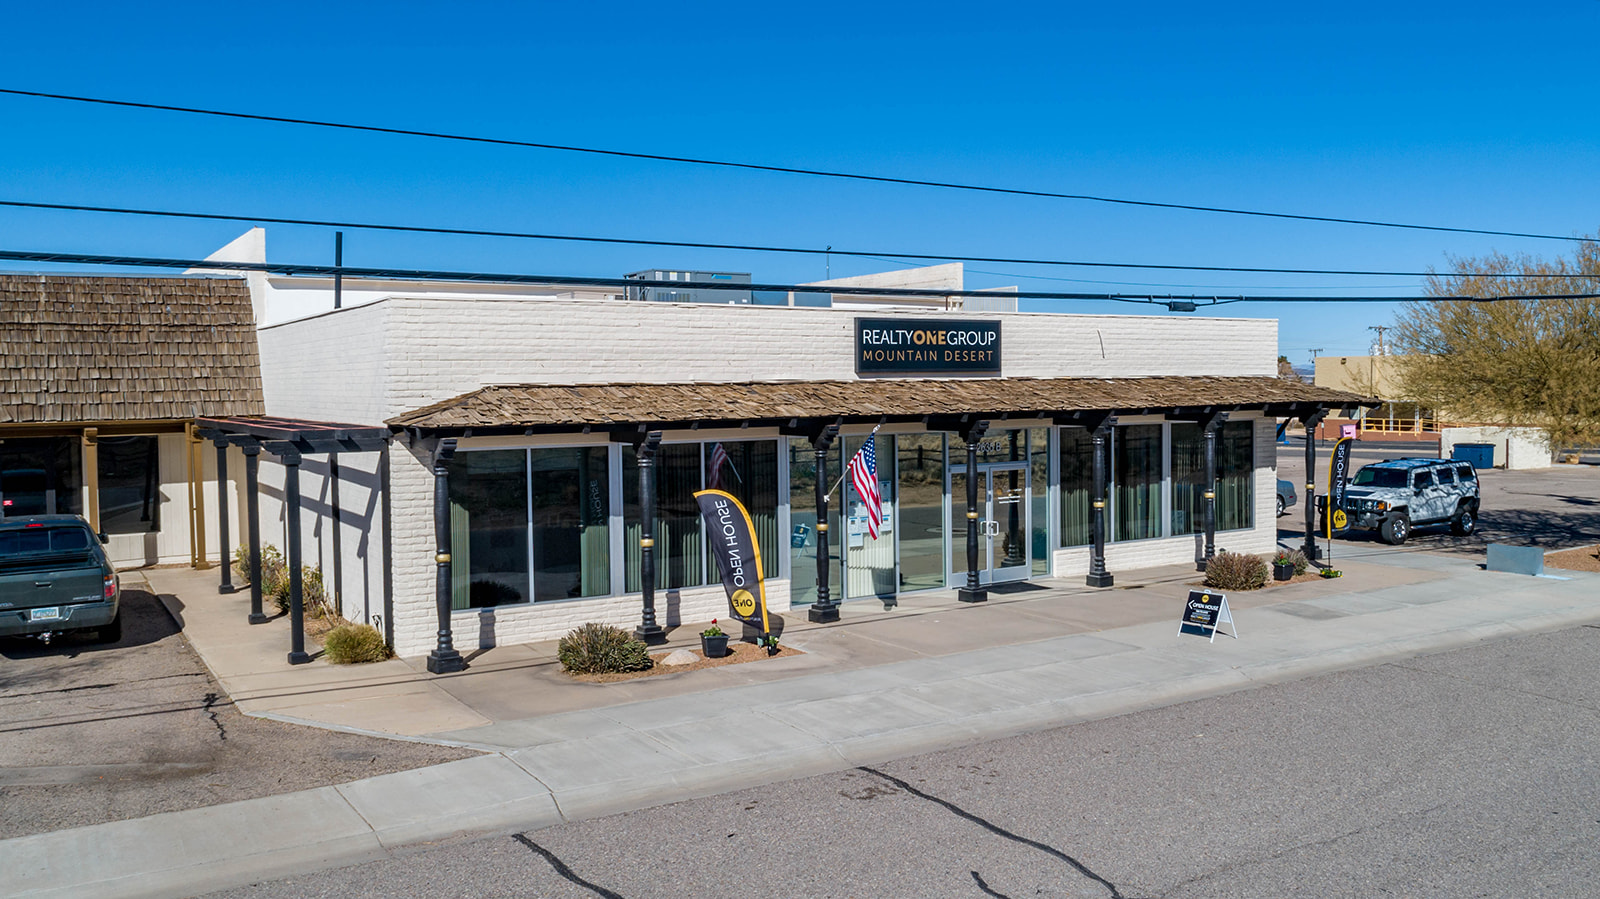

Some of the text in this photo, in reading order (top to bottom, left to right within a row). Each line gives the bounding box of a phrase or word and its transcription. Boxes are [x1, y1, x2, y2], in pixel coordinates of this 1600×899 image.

[862, 350, 994, 362] MOUNTAIN DESERT
[1336, 443, 1346, 478] HOUSE
